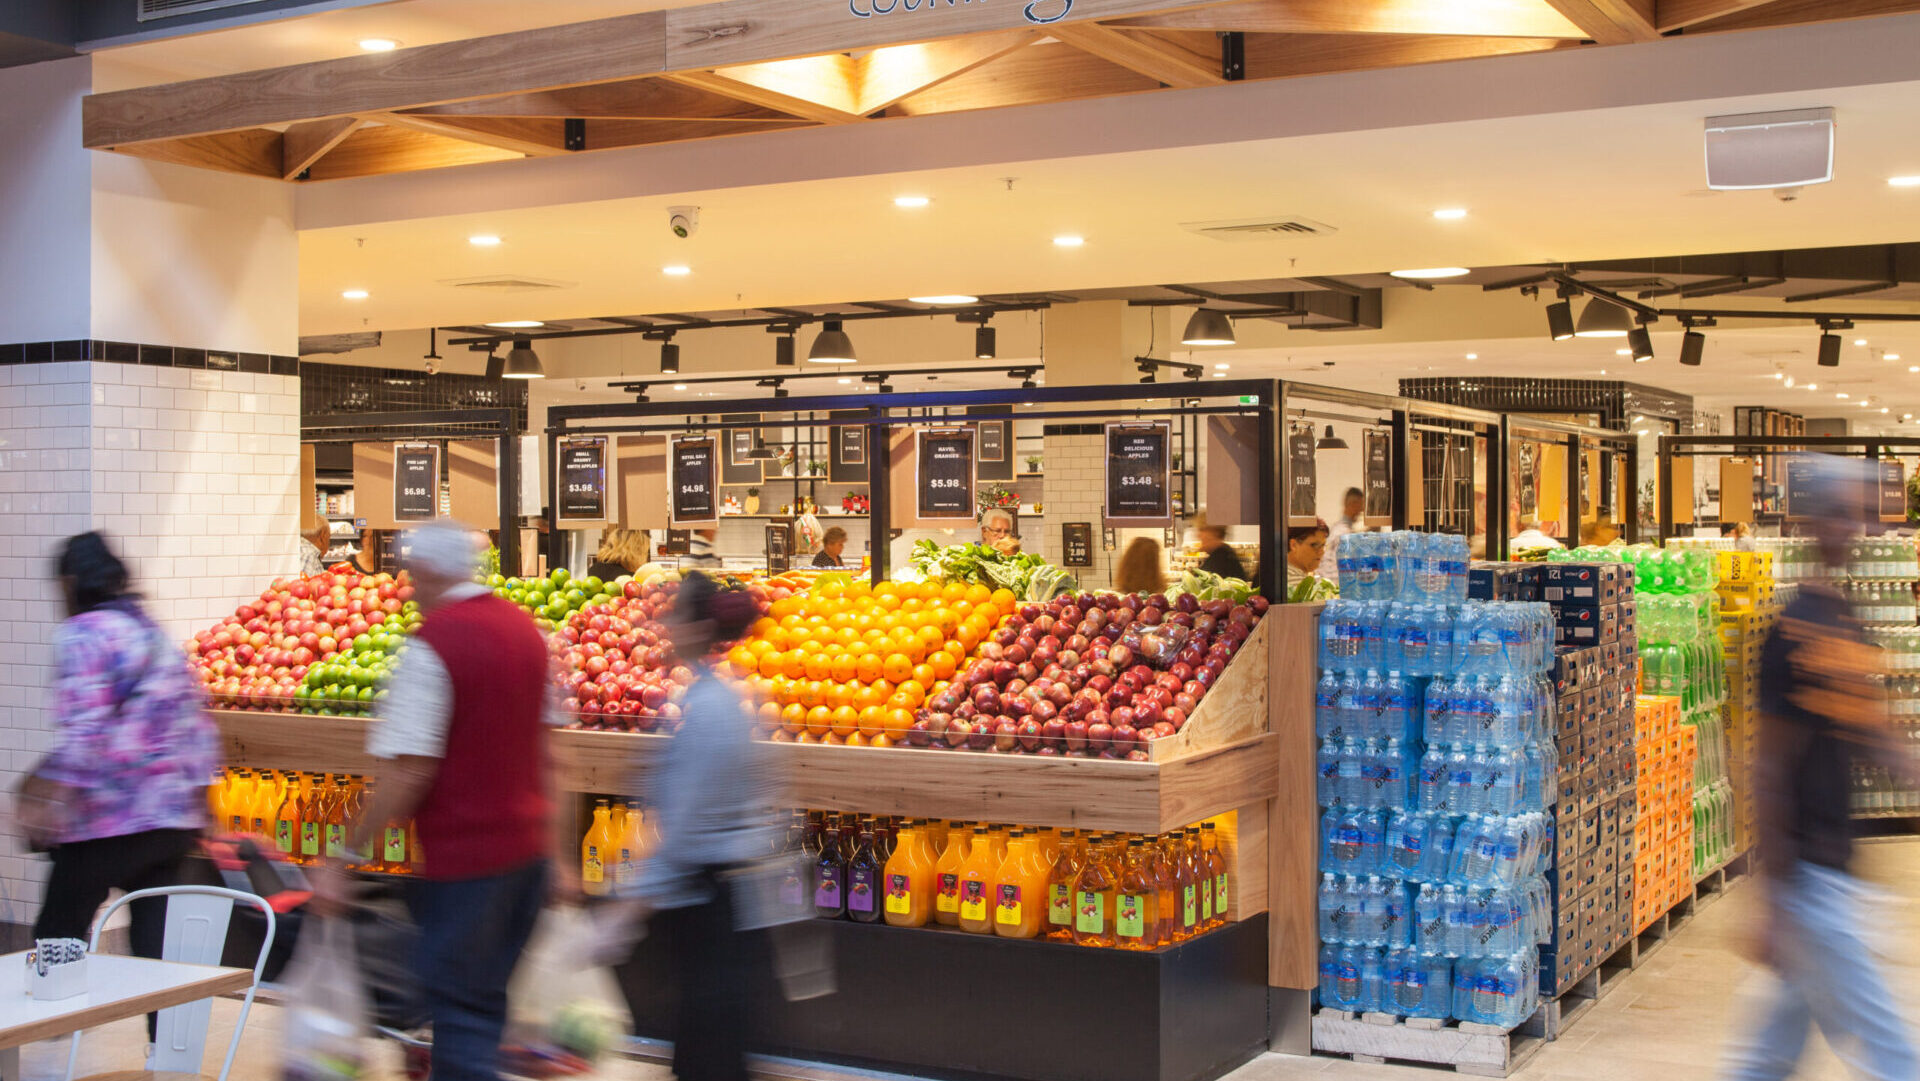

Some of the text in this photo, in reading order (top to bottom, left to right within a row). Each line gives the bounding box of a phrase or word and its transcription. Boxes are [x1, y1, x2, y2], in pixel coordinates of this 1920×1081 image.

[930, 478, 960, 488] $5.98
[1122, 476, 1152, 486] $3.48
[404, 488, 426, 496] $6.98
[569, 484, 592, 492] $3.98
[682, 484, 704, 494] $4.98
